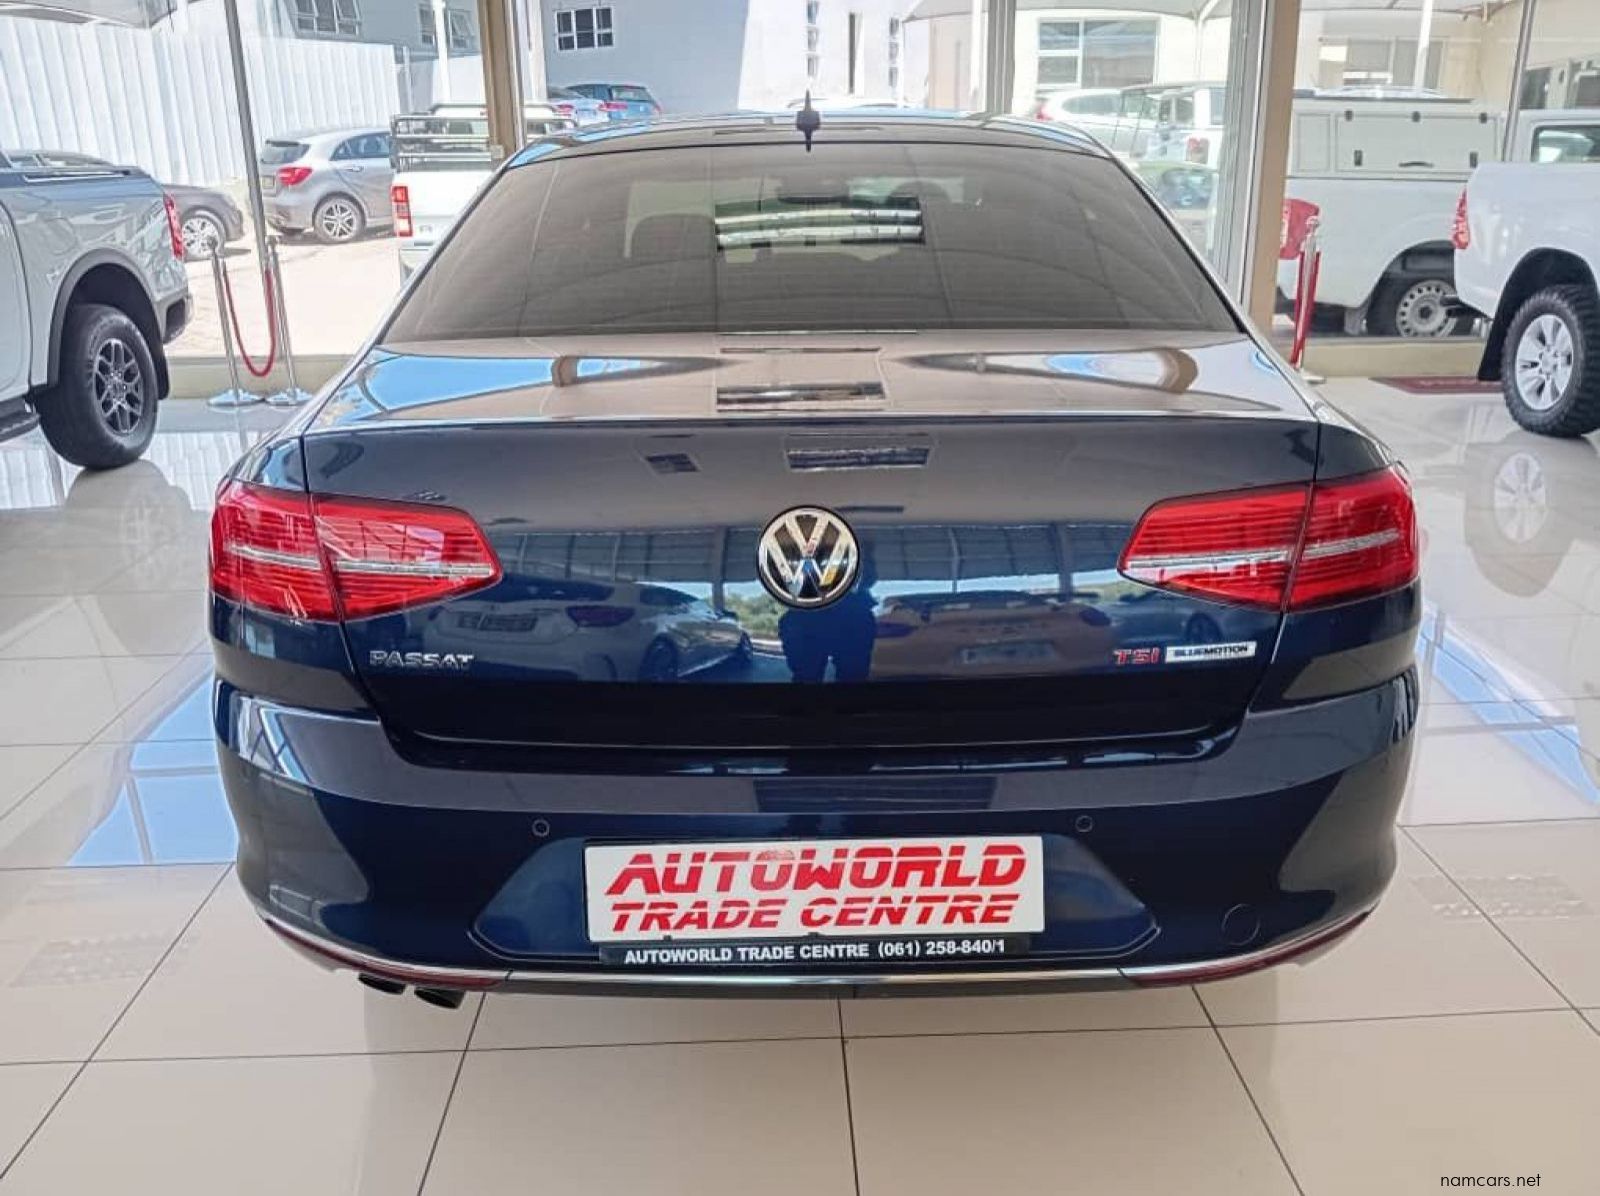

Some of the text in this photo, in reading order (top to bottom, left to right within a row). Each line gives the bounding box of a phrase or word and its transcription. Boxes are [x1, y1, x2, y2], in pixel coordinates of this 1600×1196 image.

[369, 650, 474, 669] PASSAT
[1113, 647, 1160, 665] TSI
[604, 844, 1027, 895] AUTOWORLD
[612, 893, 1019, 932] TRADE CENTRE
[624, 948, 731, 965] AUTOWORLD
[737, 945, 794, 961] TRADE
[800, 943, 869, 959] CENTRE
[878, 940, 921, 958] (061)
